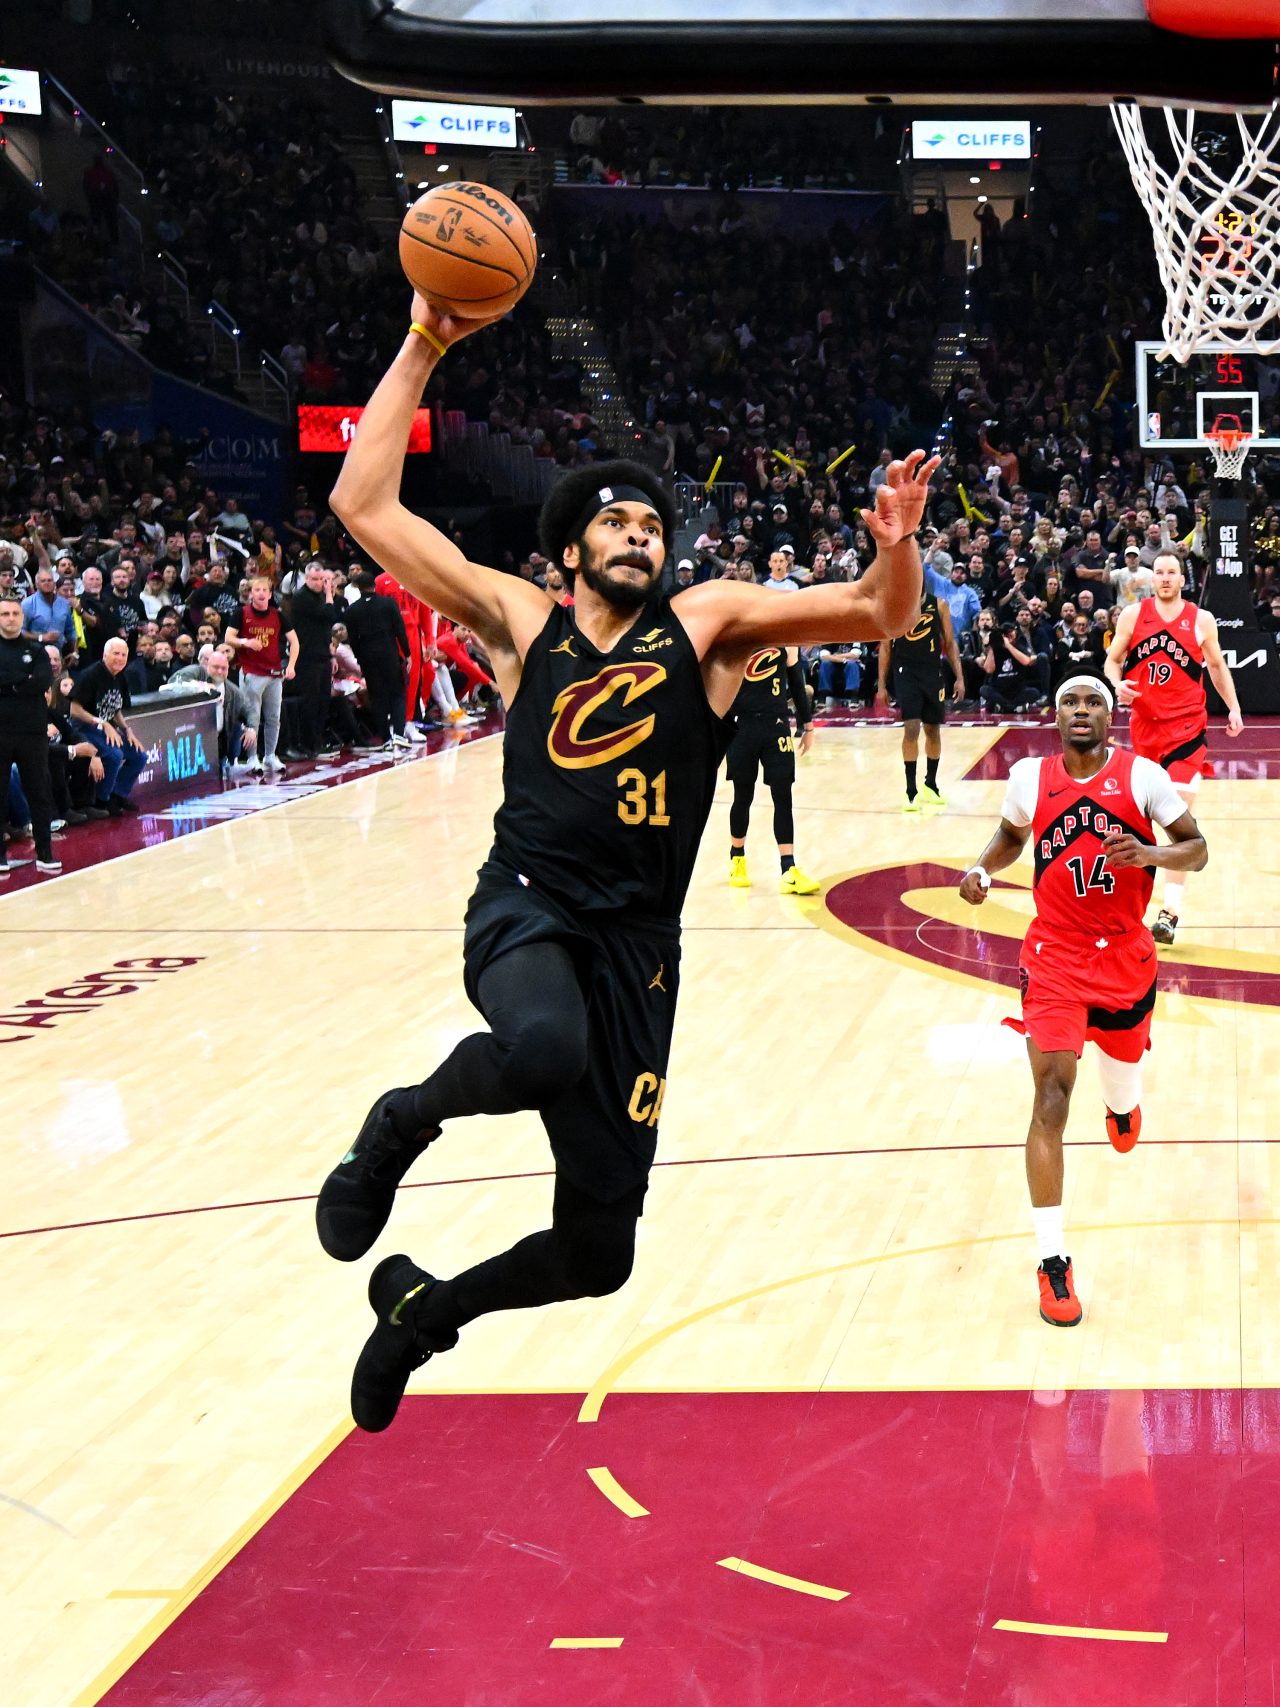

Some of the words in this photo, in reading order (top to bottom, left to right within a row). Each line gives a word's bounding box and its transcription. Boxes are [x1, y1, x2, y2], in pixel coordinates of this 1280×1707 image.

[440, 116, 511, 134] CLIFFS
[957, 133, 1025, 146] CLIFFS
[1219, 525, 1238, 542] GET
[1219, 542, 1239, 557] THE
[1224, 558, 1243, 577] App
[1215, 618, 1244, 628] Google
[632, 637, 673, 653] CLIFFS
[1147, 661, 1172, 686] 19
[771, 678, 780, 696] 5
[617, 767, 671, 826] 31
[1041, 806, 1122, 858] RAPTO
[1064, 854, 1115, 897] 14
